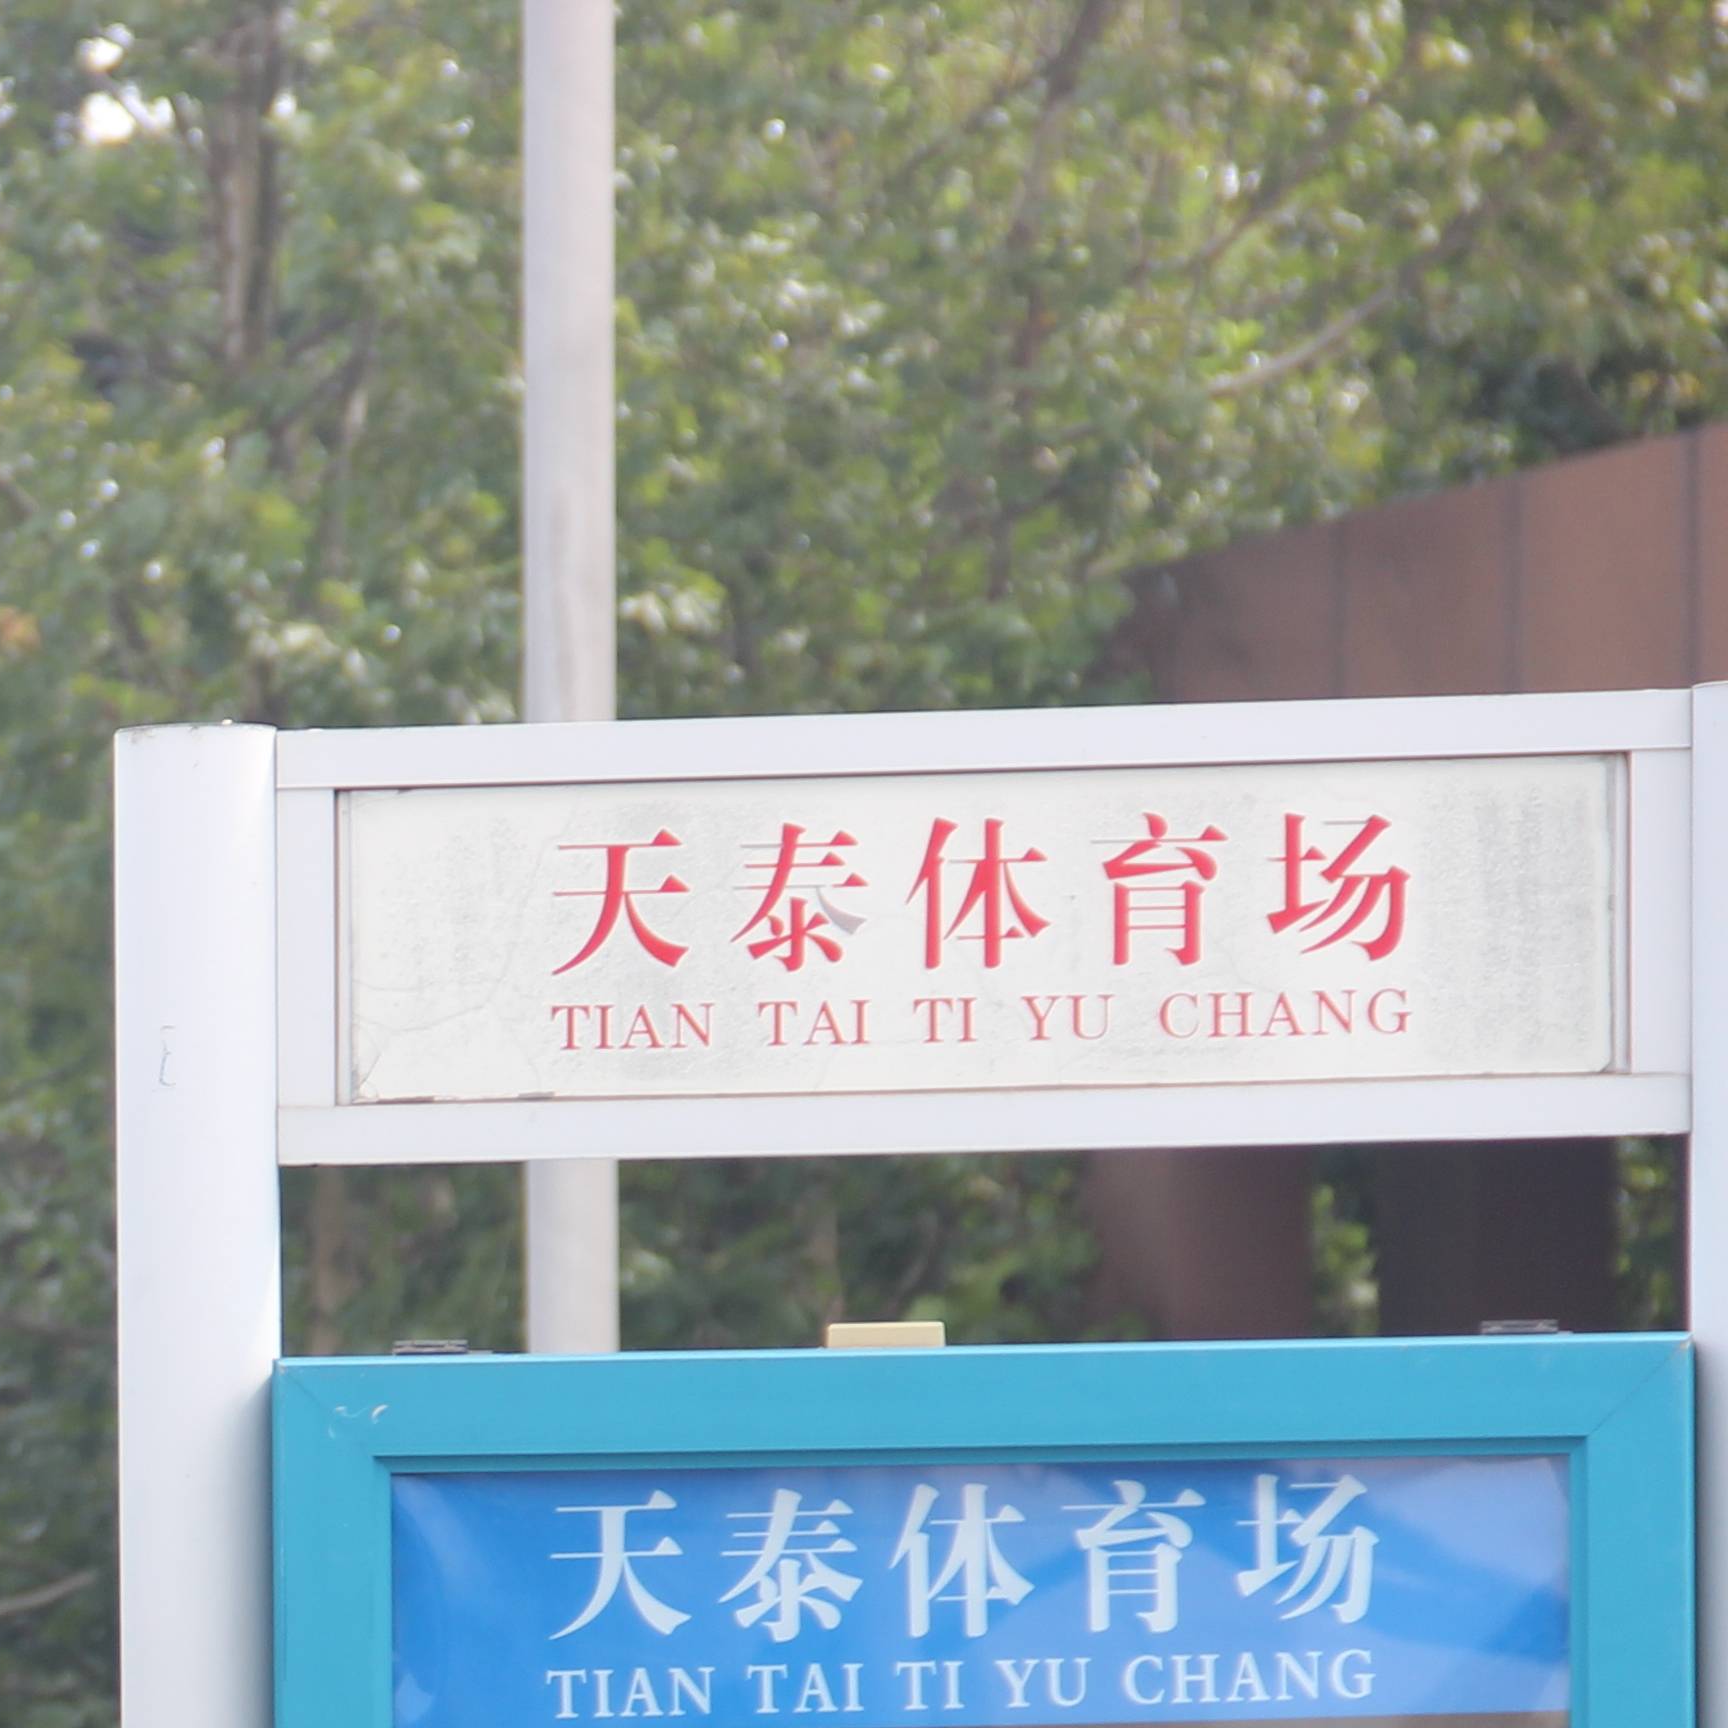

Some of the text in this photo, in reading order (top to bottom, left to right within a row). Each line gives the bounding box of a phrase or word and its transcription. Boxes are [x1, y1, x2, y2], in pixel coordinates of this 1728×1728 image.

[552, 813, 1409, 975] 天泰体育场
[551, 989, 1410, 1050] TIAN TAI TI YU CHANG
[547, 1471, 1380, 1644] 天泰体育场
[546, 1649, 1377, 1721] TIAN TAI TI YU CHANG
